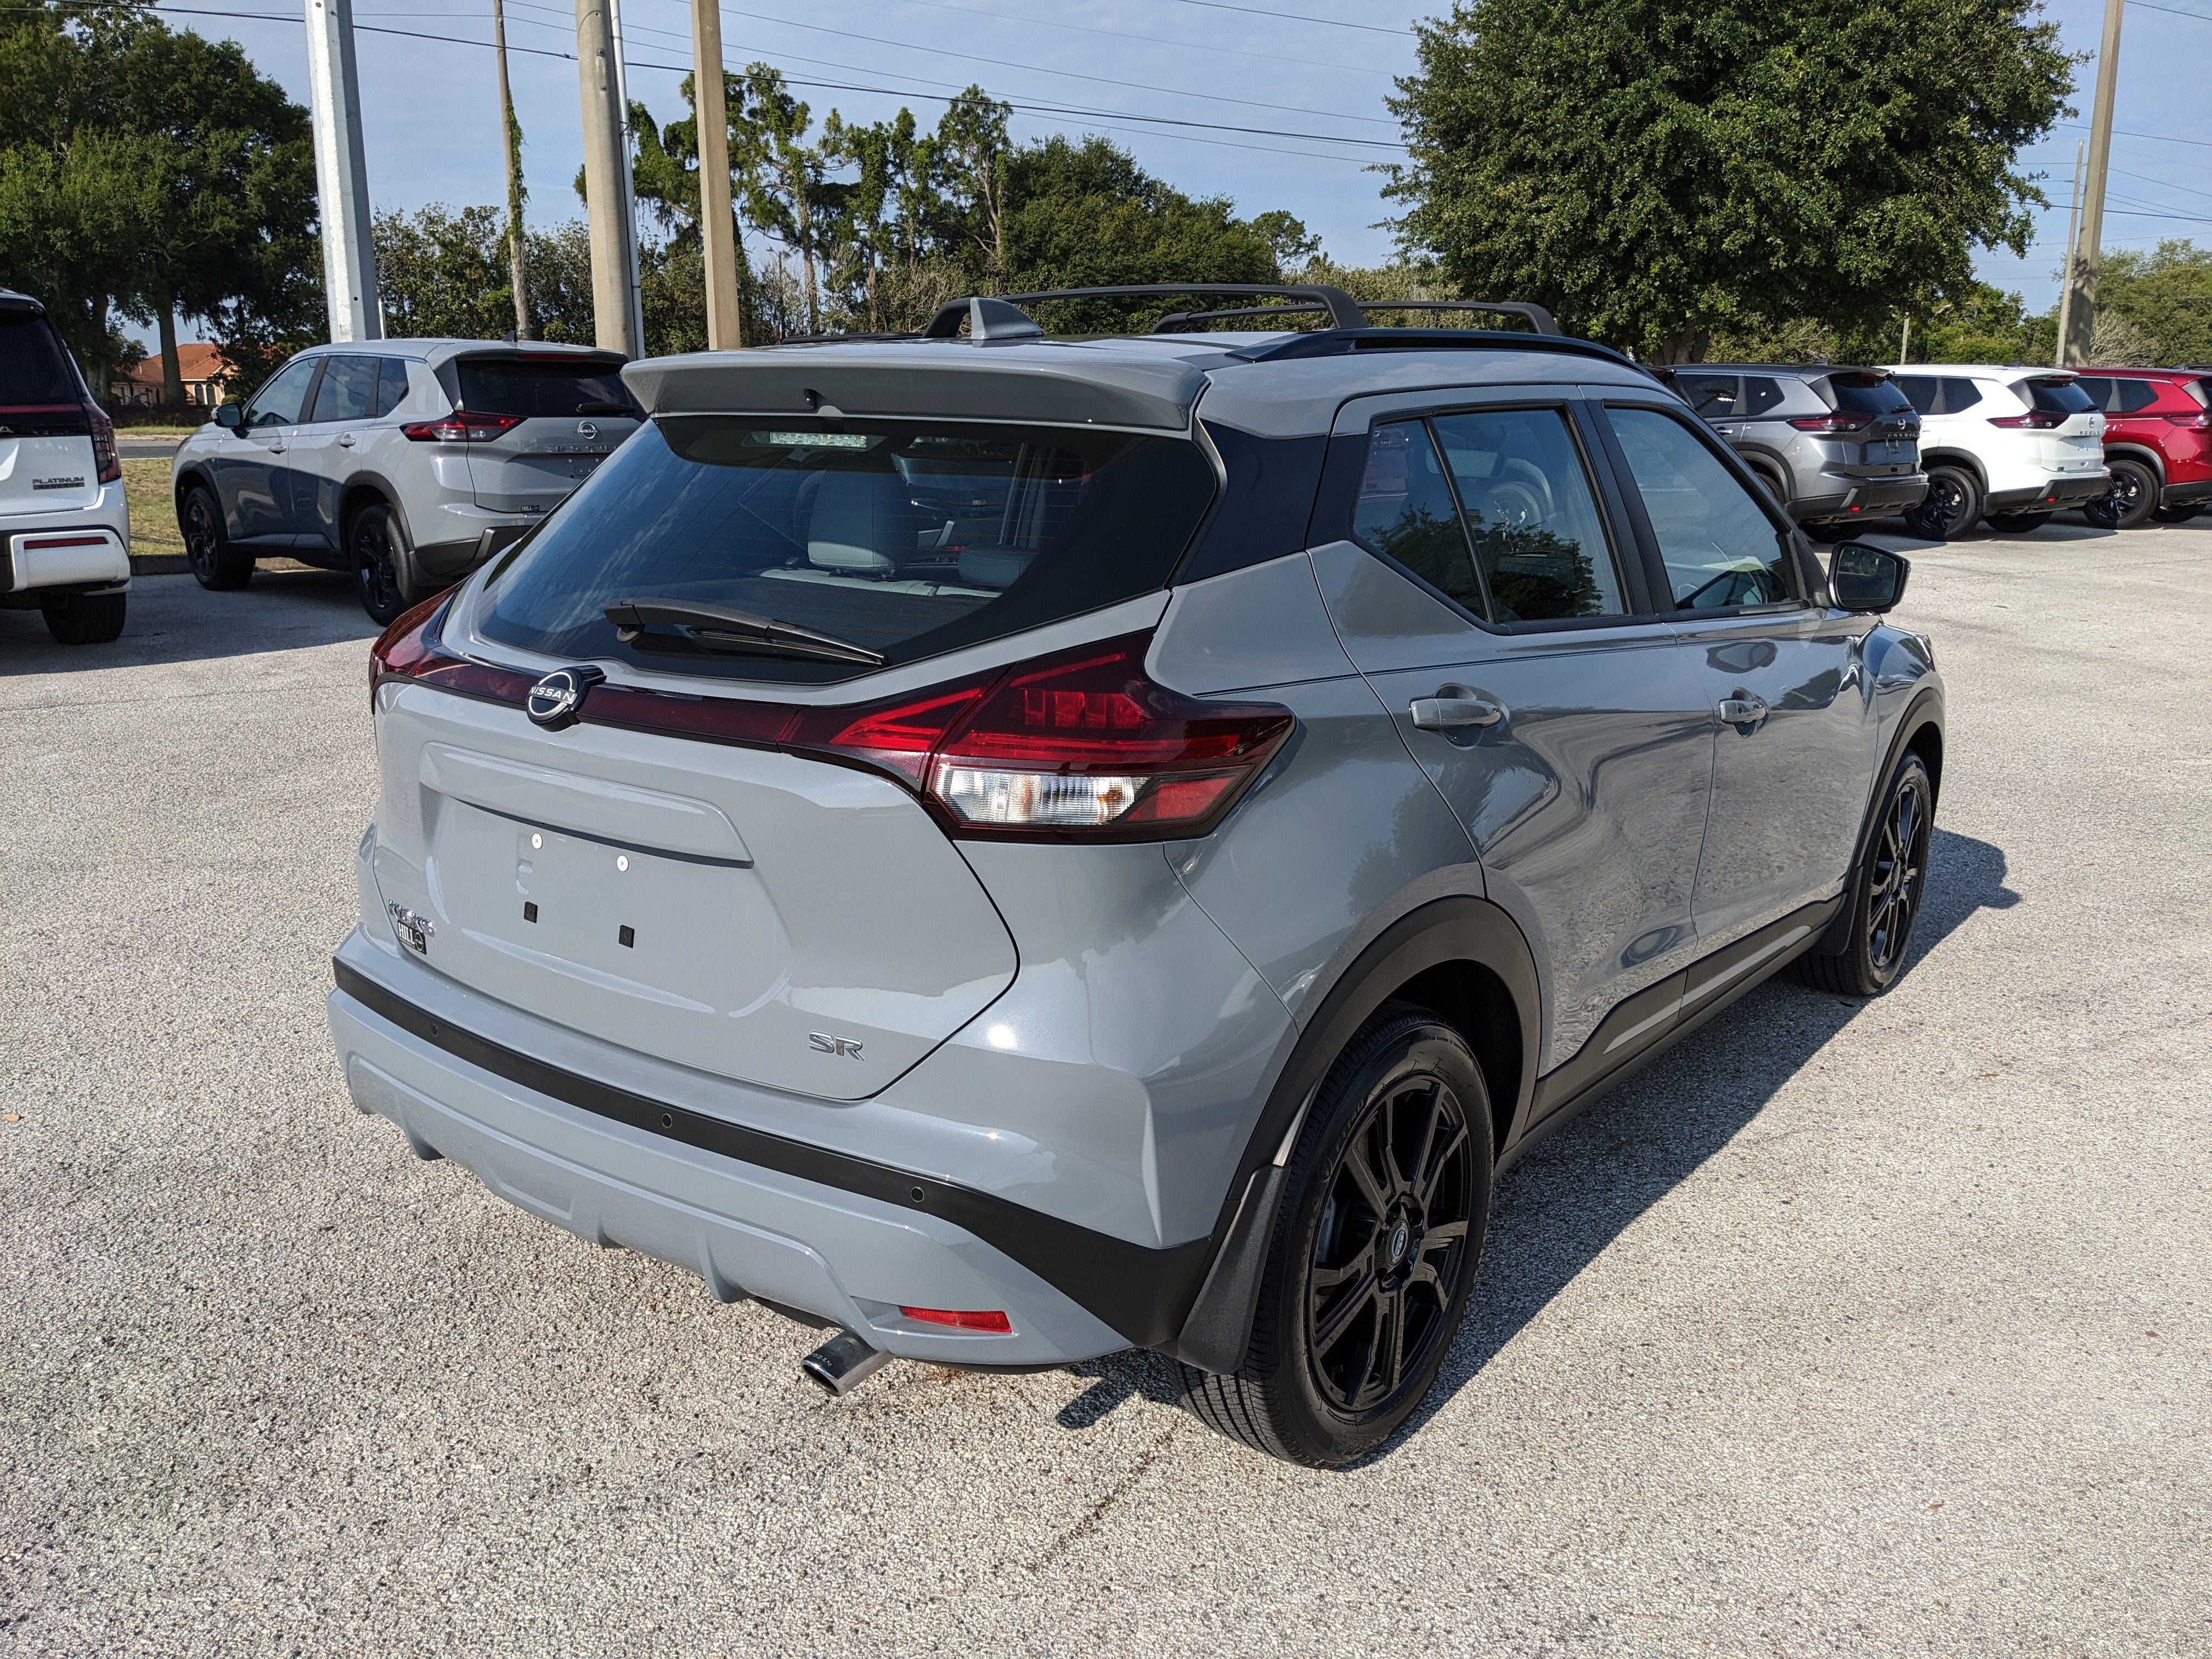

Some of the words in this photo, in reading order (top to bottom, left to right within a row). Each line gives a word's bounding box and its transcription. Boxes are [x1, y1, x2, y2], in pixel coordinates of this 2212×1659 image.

[33, 476, 84, 484] PLATINUM
[529, 686, 577, 704] NISSAN
[388, 899, 435, 938] KICKS
[398, 922, 415, 945] HILL
[809, 1029, 865, 1061] SR
